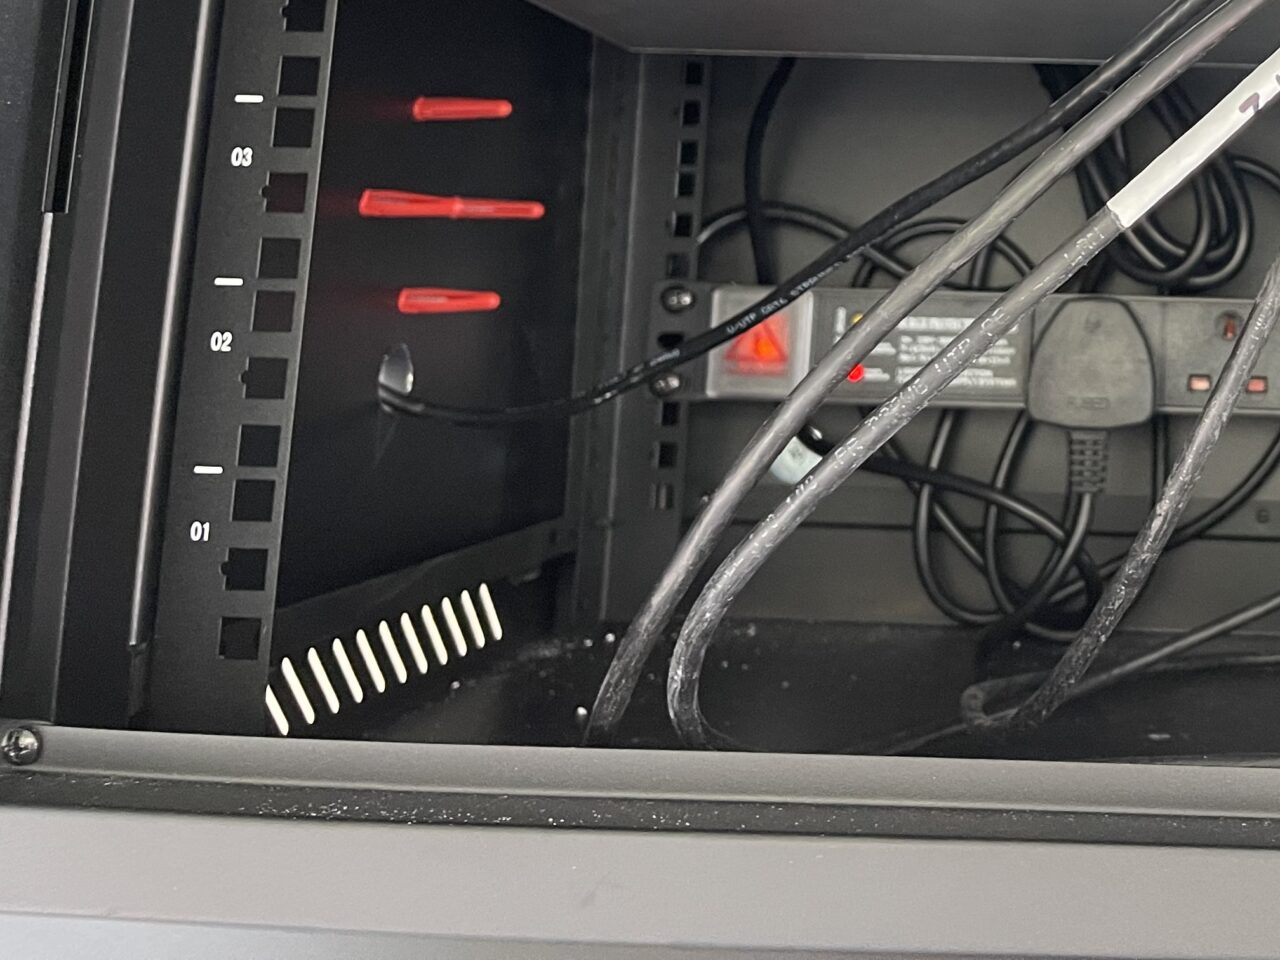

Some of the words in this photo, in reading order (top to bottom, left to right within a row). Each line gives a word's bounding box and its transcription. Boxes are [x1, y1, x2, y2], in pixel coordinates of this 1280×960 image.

[230, 146, 254, 168] 03
[209, 331, 233, 353] 02
[933, 338, 971, 373] UTP
[189, 520, 210, 542] 01
